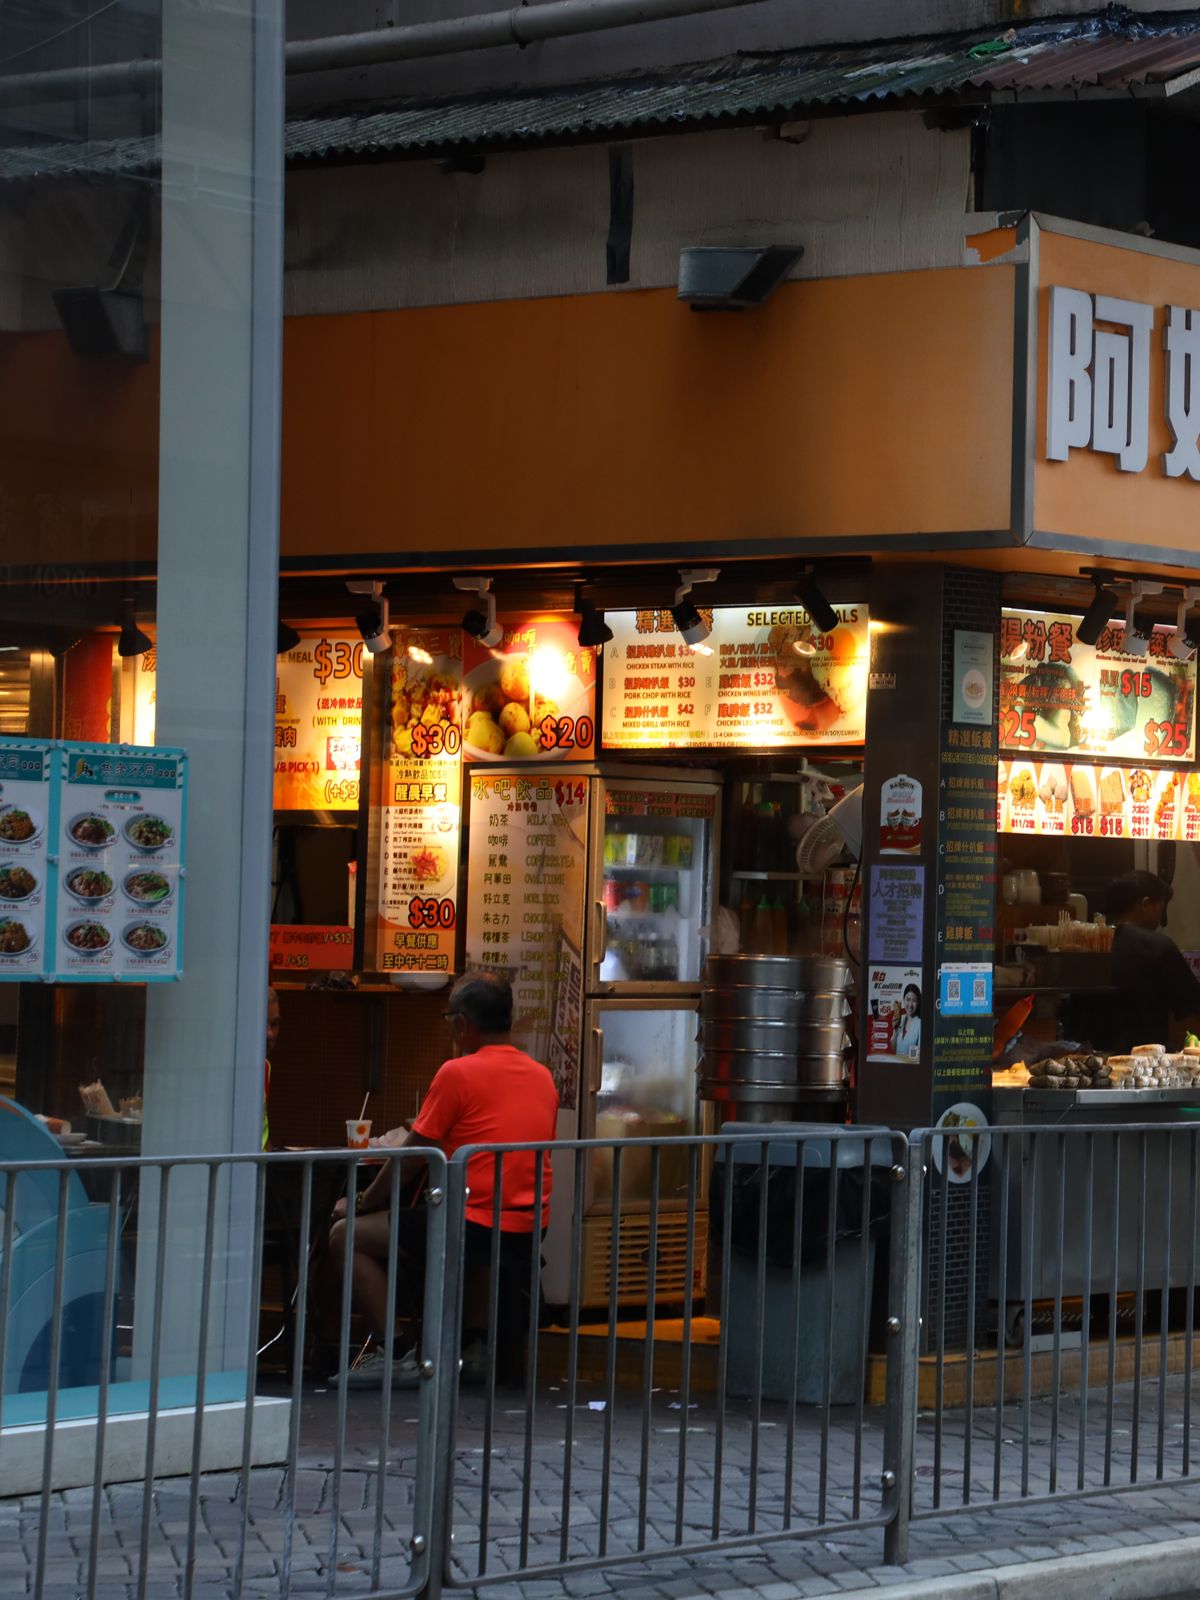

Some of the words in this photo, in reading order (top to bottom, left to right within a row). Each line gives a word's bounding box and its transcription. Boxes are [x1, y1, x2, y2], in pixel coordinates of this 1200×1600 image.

[746, 611, 811, 627] SELECTED
[834, 609, 858, 624] ALS
[289, 652, 313, 663] MEAL
[678, 676, 695, 688] $30
[754, 672, 774, 687] $32
[1121, 671, 1152, 698] $15
[677, 704, 694, 715] $42
[754, 703, 772, 715] $32
[677, 720, 690, 728] RICE
[411, 722, 461, 756] $30
[540, 715, 594, 750] $20
[1144, 719, 1187, 757] $25
[289, 762, 308, 772] PICK
[395, 783, 448, 803] 醒晨早餐
[473, 778, 553, 801] 水吧飲品
[555, 780, 585, 807] $14
[490, 813, 509, 827] 奶茶
[526, 814, 547, 826] MILK
[1071, 816, 1094, 835] $15
[1100, 816, 1123, 836] $15
[488, 834, 509, 847] 咖啡
[484, 873, 512, 885] 阿華田
[483, 893, 511, 905] 好立克
[408, 896, 456, 928] $30
[483, 912, 510, 925] 朱古力
[394, 932, 438, 949] 早餐供應
[383, 953, 448, 969] 至中午十二時
